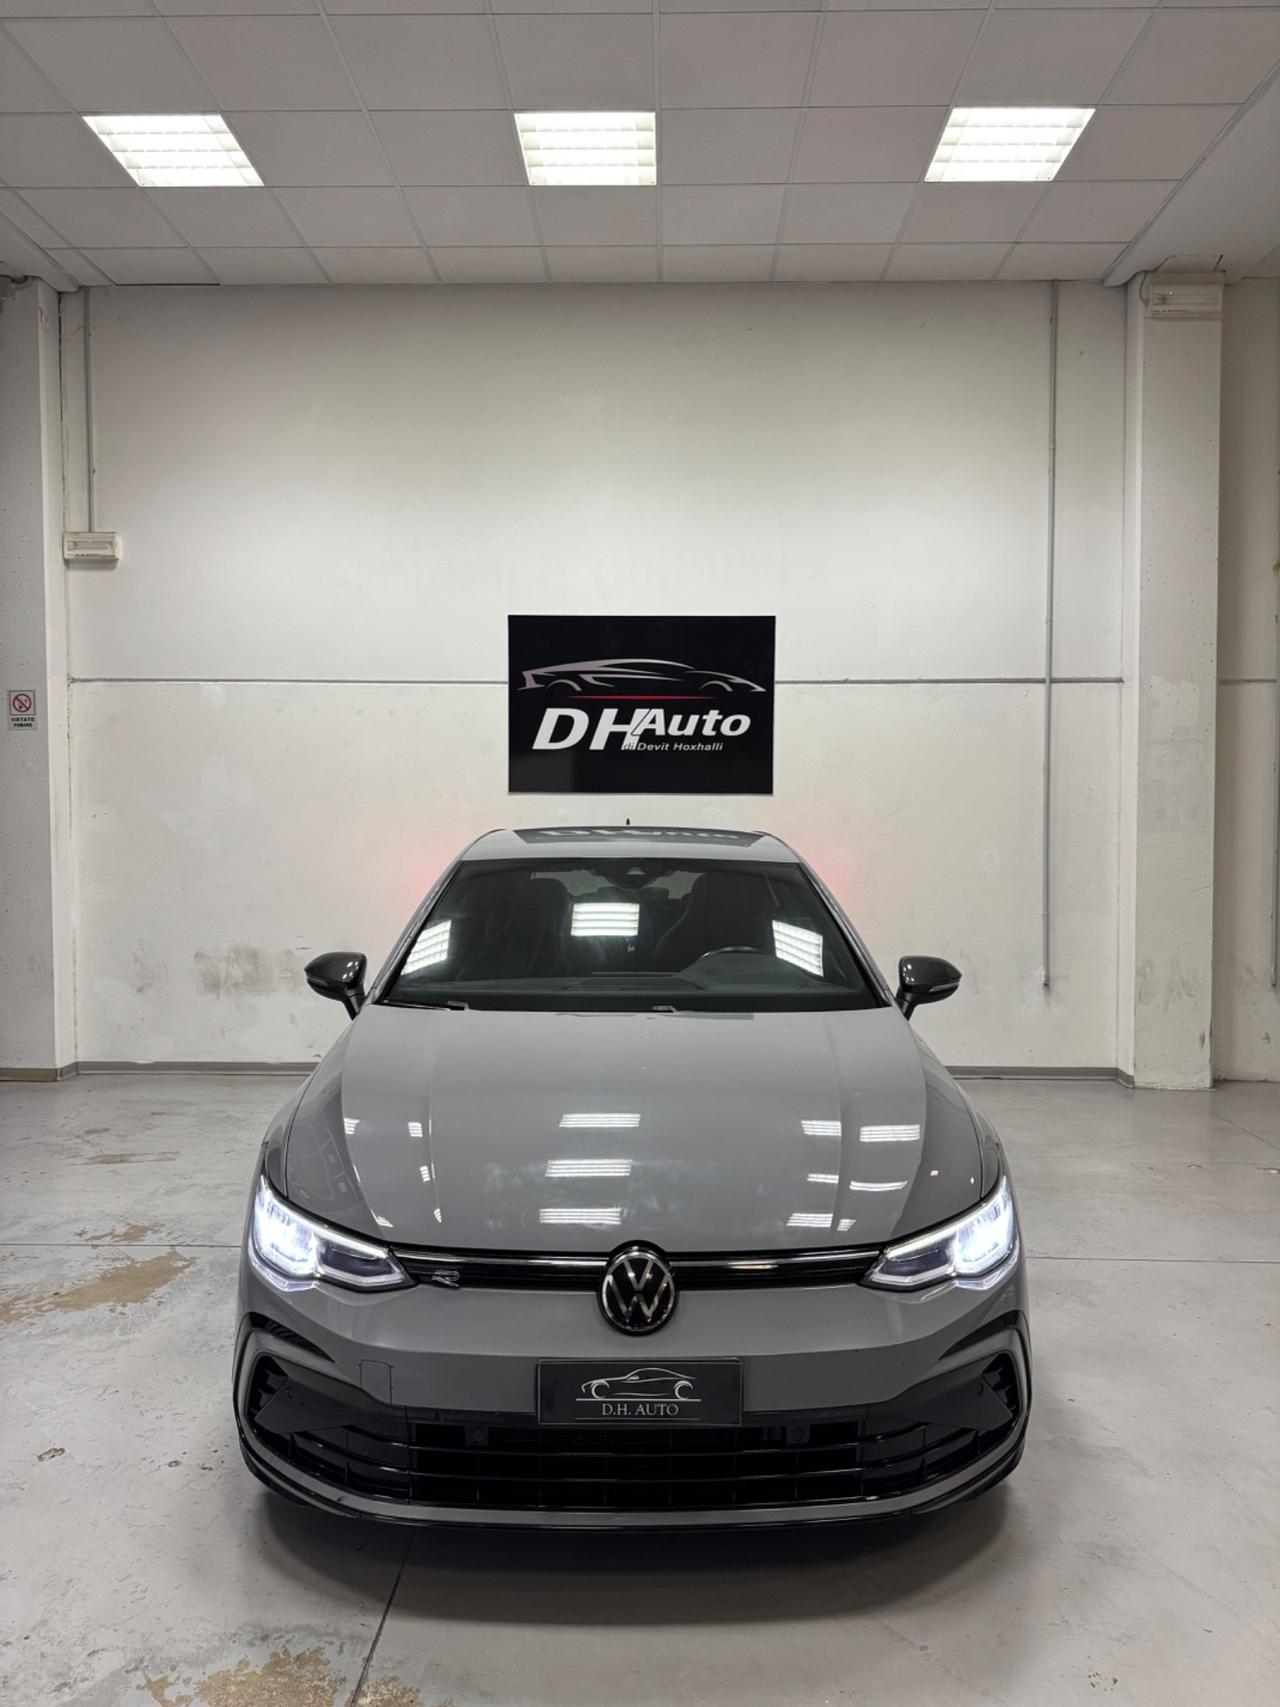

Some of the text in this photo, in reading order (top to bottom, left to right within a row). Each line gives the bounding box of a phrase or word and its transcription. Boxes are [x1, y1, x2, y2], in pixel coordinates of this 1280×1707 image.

[637, 742, 669, 751] Devit
[673, 742, 724, 751] Hoxhalli
[602, 1403, 679, 1416] D.H. AUTO
